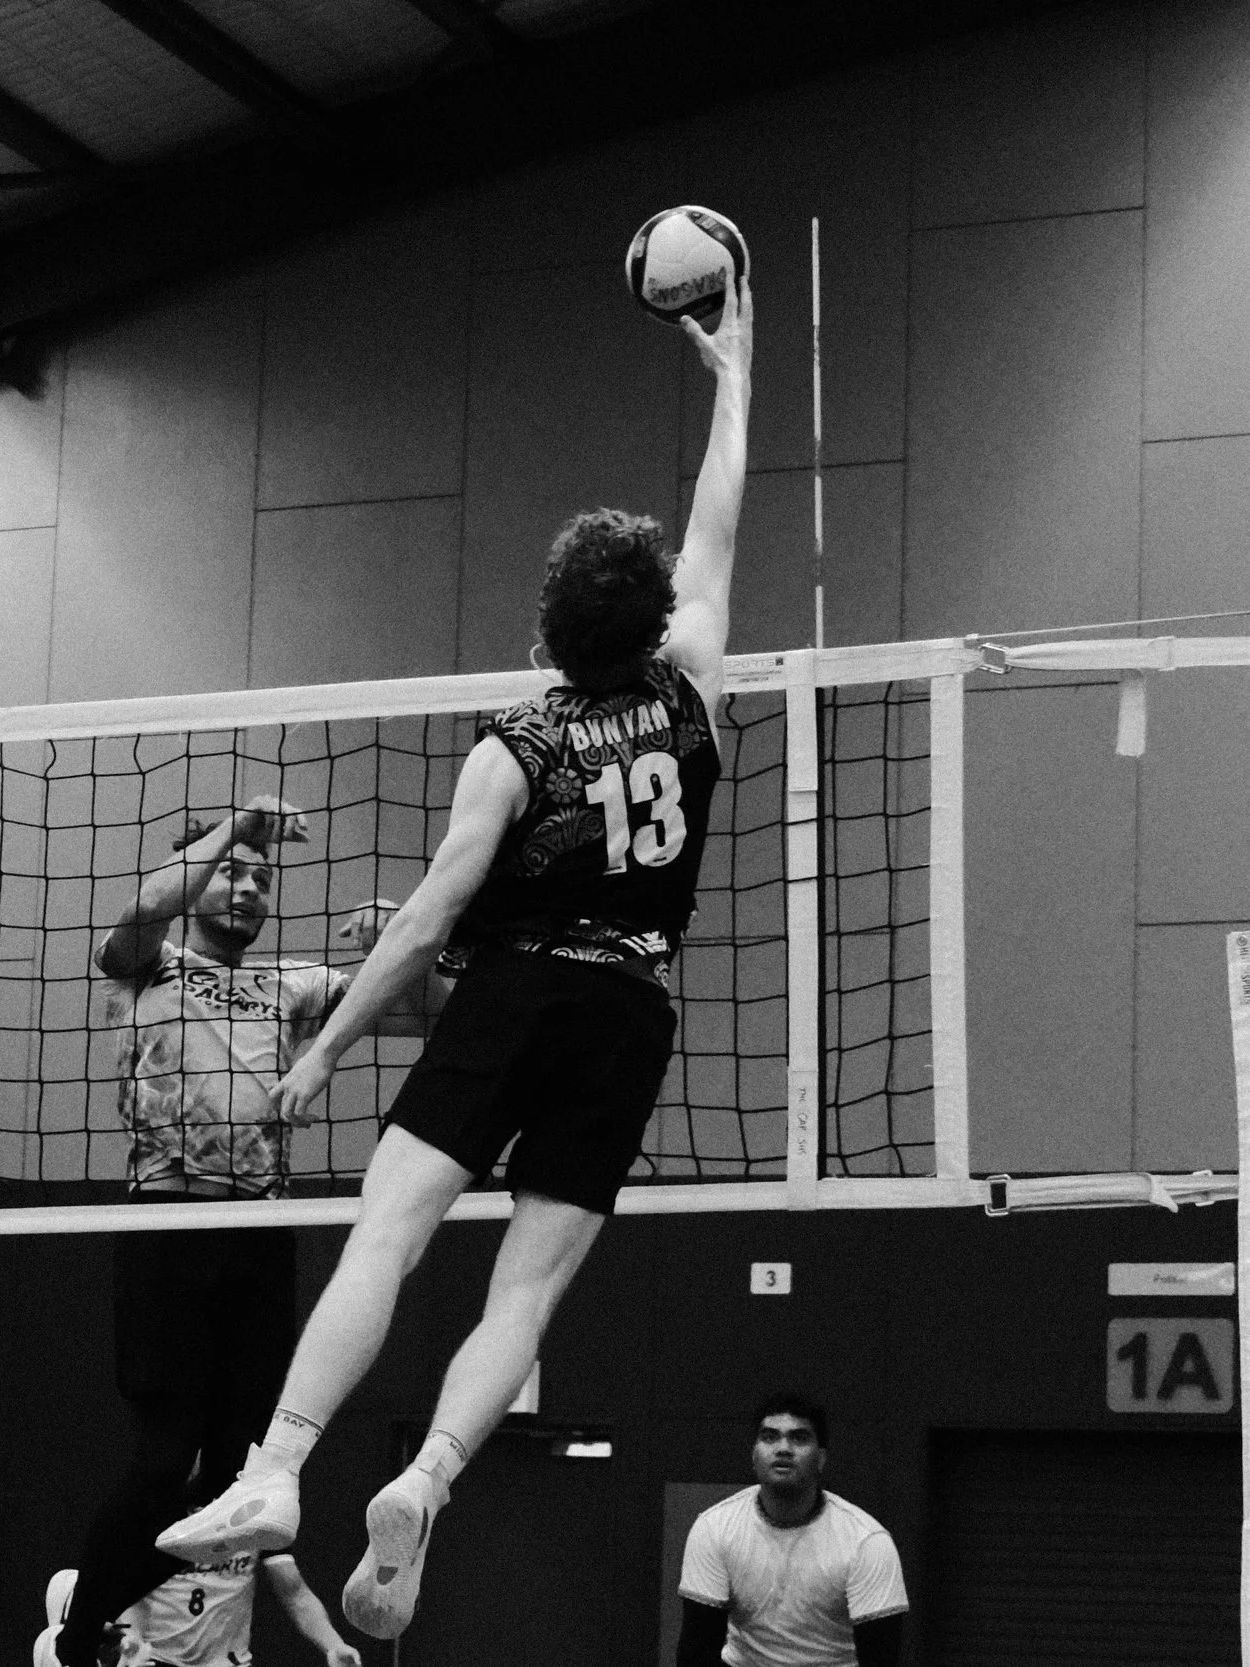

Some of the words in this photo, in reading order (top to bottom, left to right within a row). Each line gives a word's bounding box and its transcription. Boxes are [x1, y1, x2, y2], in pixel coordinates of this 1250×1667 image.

[567, 699, 671, 752] BUNYAN
[584, 751, 688, 876] 13
[765, 1270, 776, 1287] 3
[1116, 1331, 1221, 1401] 1A
[188, 1588, 206, 1616] 8
